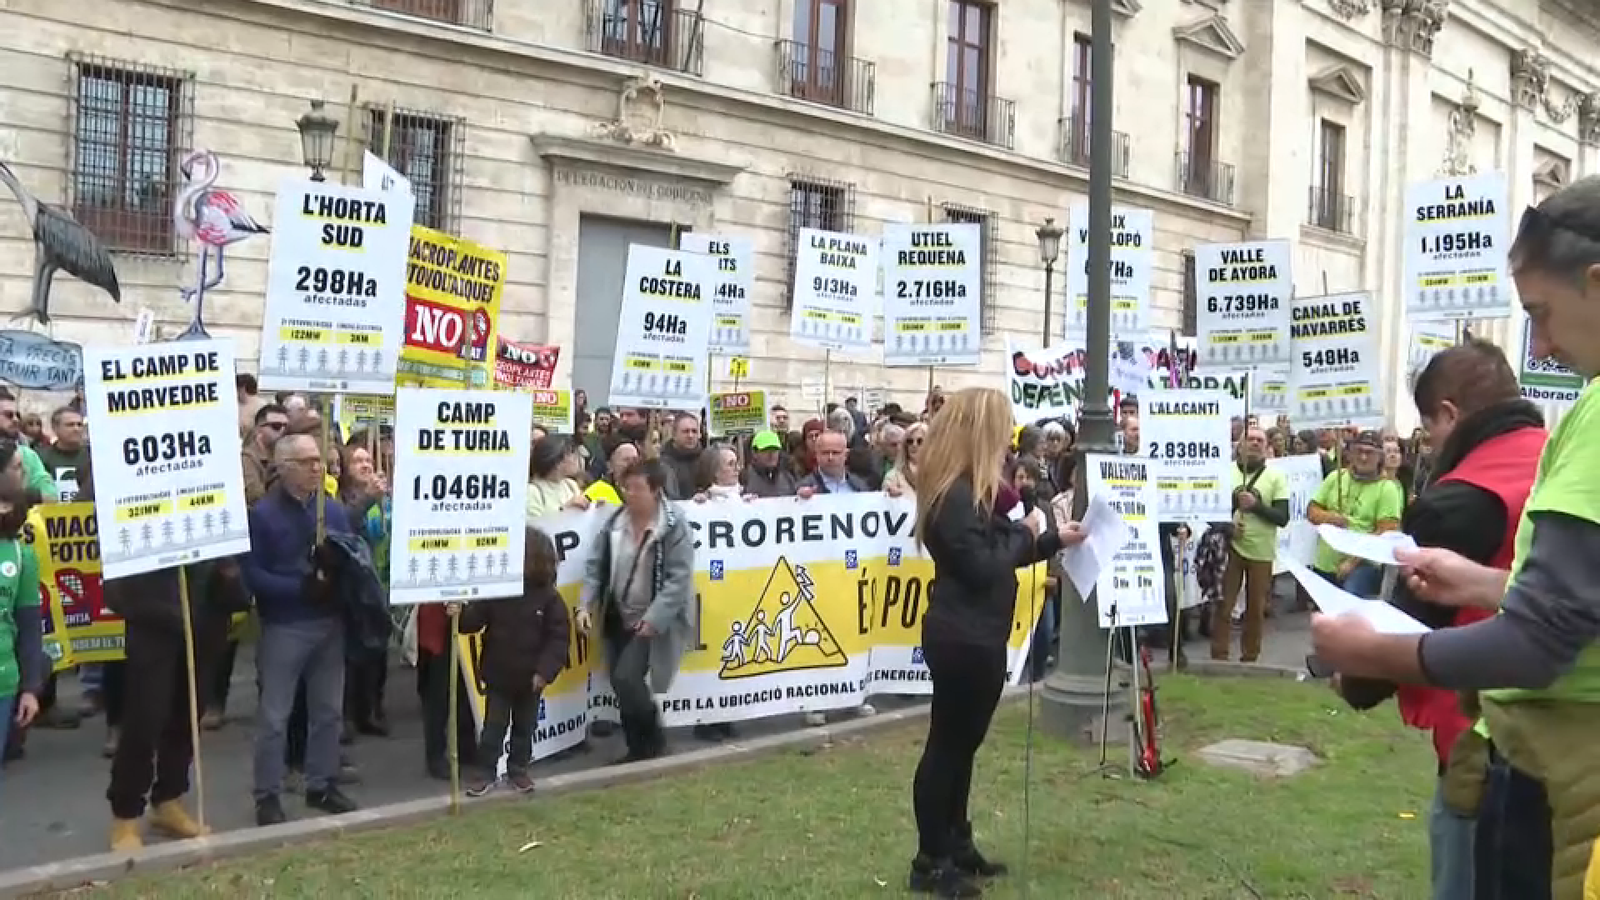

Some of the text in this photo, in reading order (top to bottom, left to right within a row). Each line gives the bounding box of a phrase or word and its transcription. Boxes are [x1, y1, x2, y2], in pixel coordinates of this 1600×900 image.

[1445, 185, 1464, 200] LA
[303, 193, 386, 224] L'HORTA
[1416, 196, 1495, 221] SERRANÍA
[321, 223, 364, 247] SUD
[812, 235, 867, 255] LA PLANA
[911, 232, 953, 248] UTIEL
[1421, 231, 1493, 253] 1.195Ha
[709, 241, 730, 255] ELS
[898, 250, 966, 265] REQUENA
[1221, 248, 1264, 264] VALLE
[665, 258, 681, 277] LA
[820, 252, 856, 269] BAIXA
[295, 266, 378, 297] 298Ha
[1209, 265, 1277, 282] DE AYORA
[640, 276, 701, 300] COSTERA
[813, 276, 857, 297] 913Ha
[897, 280, 967, 298] 2.716Ha
[303, 294, 367, 307] afectadas
[1208, 293, 1279, 313] 6.739Ha
[1292, 301, 1362, 321] CANAL DE
[411, 305, 463, 347] NO
[644, 311, 687, 334] 94Ha
[505, 343, 536, 364] NO
[1303, 348, 1359, 367] 548Ha
[101, 352, 219, 380] EL CAMP DE
[107, 381, 219, 413] MORVEDRE
[725, 395, 749, 407] NO
[438, 401, 496, 423] CAMP
[122, 430, 212, 465] 603Ha
[418, 429, 510, 451] DE TURIA
[136, 457, 204, 477] afectadas
[1100, 461, 1148, 481] VALENCIA
[413, 474, 510, 500] 1.046Ha
[431, 501, 492, 512] afectadas
[662, 698, 690, 713] PER
[696, 697, 714, 710] LA
[720, 687, 782, 709] UBICACIÓ
[786, 679, 857, 699] RACIONAL
